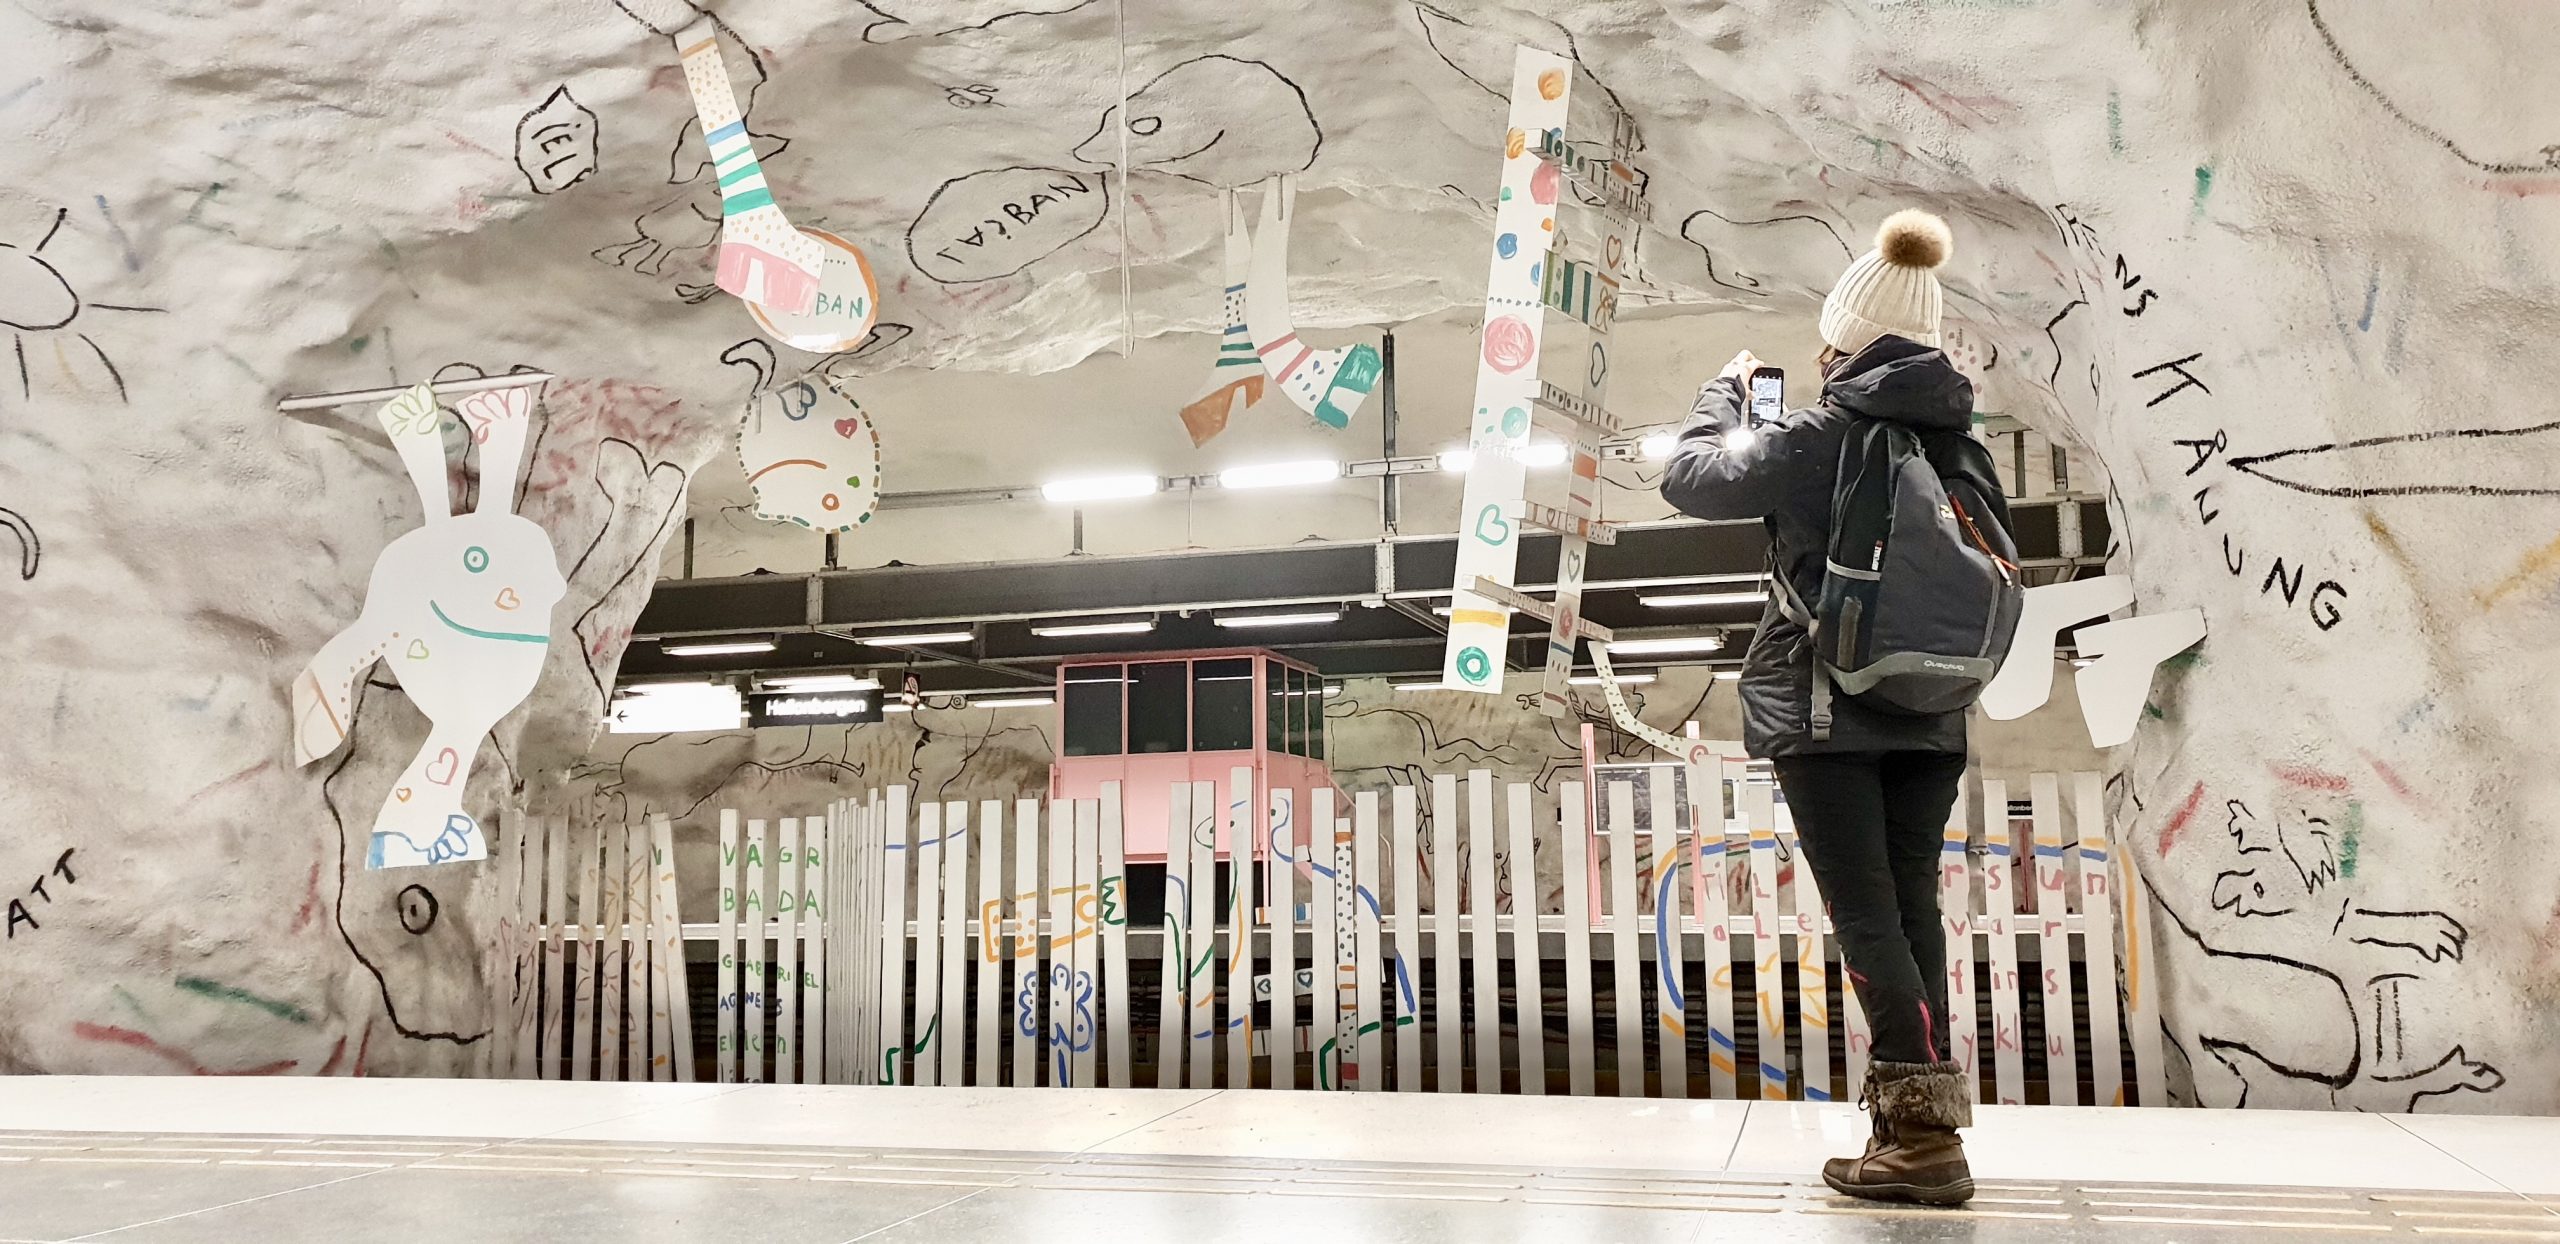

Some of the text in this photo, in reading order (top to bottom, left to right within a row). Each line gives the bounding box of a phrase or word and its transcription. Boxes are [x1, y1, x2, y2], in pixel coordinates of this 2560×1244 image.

[1923, 659, 1965, 671] Quechua
[8, 847, 76, 939] ATT
[723, 887, 821, 917] BADA
